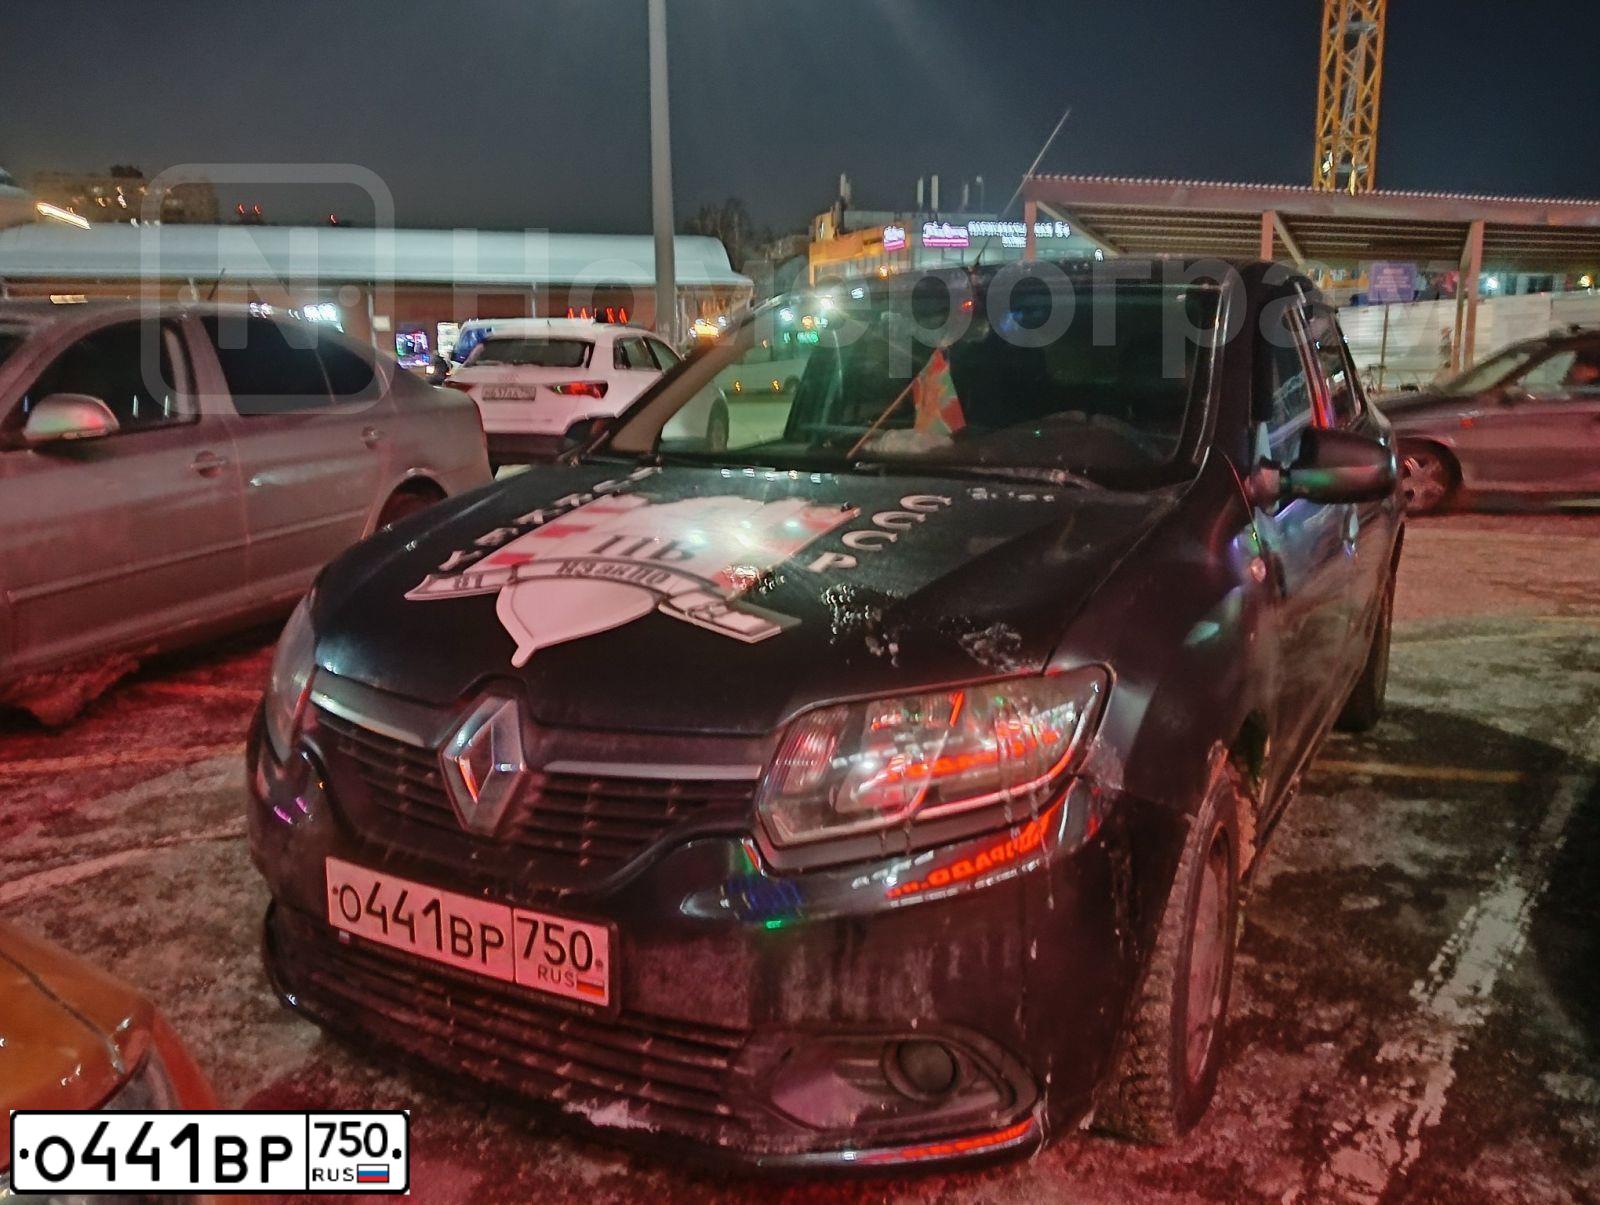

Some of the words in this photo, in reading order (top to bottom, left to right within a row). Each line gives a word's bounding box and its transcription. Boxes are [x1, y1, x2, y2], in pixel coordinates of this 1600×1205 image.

[339, 881, 505, 964] О441ВР
[516, 917, 593, 972] 750
[537, 963, 576, 987] RUS
